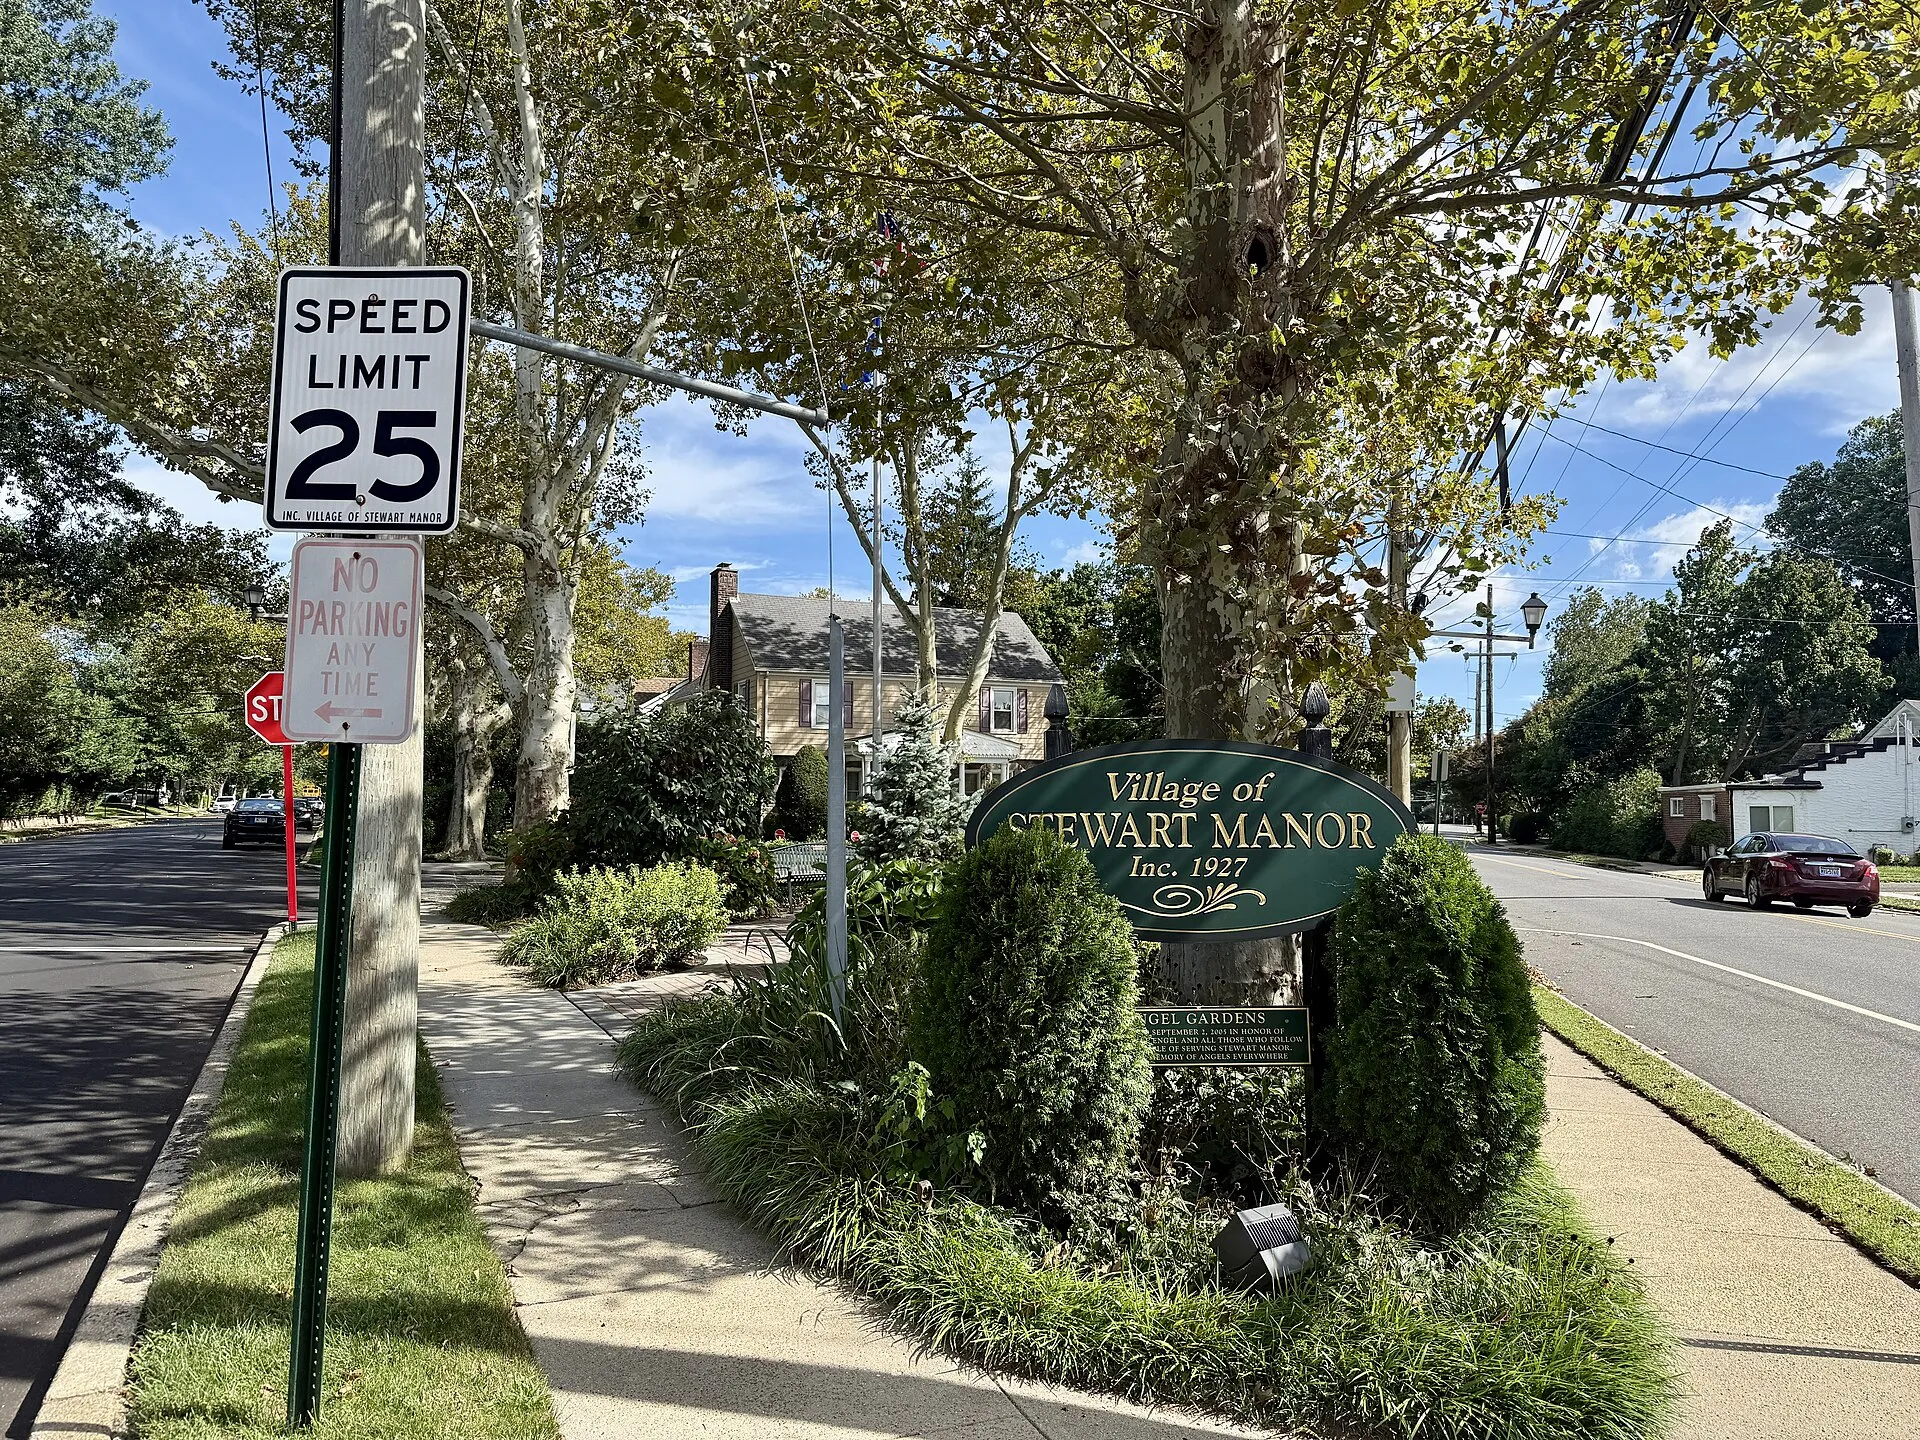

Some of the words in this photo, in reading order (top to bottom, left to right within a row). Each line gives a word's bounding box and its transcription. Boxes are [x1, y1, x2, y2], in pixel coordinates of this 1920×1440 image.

[293, 298, 451, 334] SPEED
[308, 354, 431, 390] LIMIT
[284, 408, 441, 503] 25
[282, 510, 301, 521] INC.
[306, 511, 343, 522] VILLAGE
[347, 511, 360, 522] OF
[364, 511, 405, 523] STEWART
[409, 512, 442, 523] MANOR
[332, 556, 379, 593] NO
[298, 599, 408, 638] PARKING
[326, 641, 376, 667] ANY
[320, 671, 379, 697] TIME
[251, 695, 283, 722] ST
[1106, 771, 1222, 809] Village
[1232, 771, 1276, 803] of
[1210, 812, 1377, 849] MANOR
[1128, 855, 1178, 878] Inc.
[1190, 857, 1249, 878] 1927
[1151, 1028, 1200, 1036] SEPTEMBER
[1273, 1027, 1285, 1035] OF
[1186, 1012, 1266, 1025] GARDENS
[1155, 1053, 1185, 1061] EMORY
[1233, 1052, 1289, 1060] EVERYWHERE
[1218, 1044, 1257, 1052] STEWART
